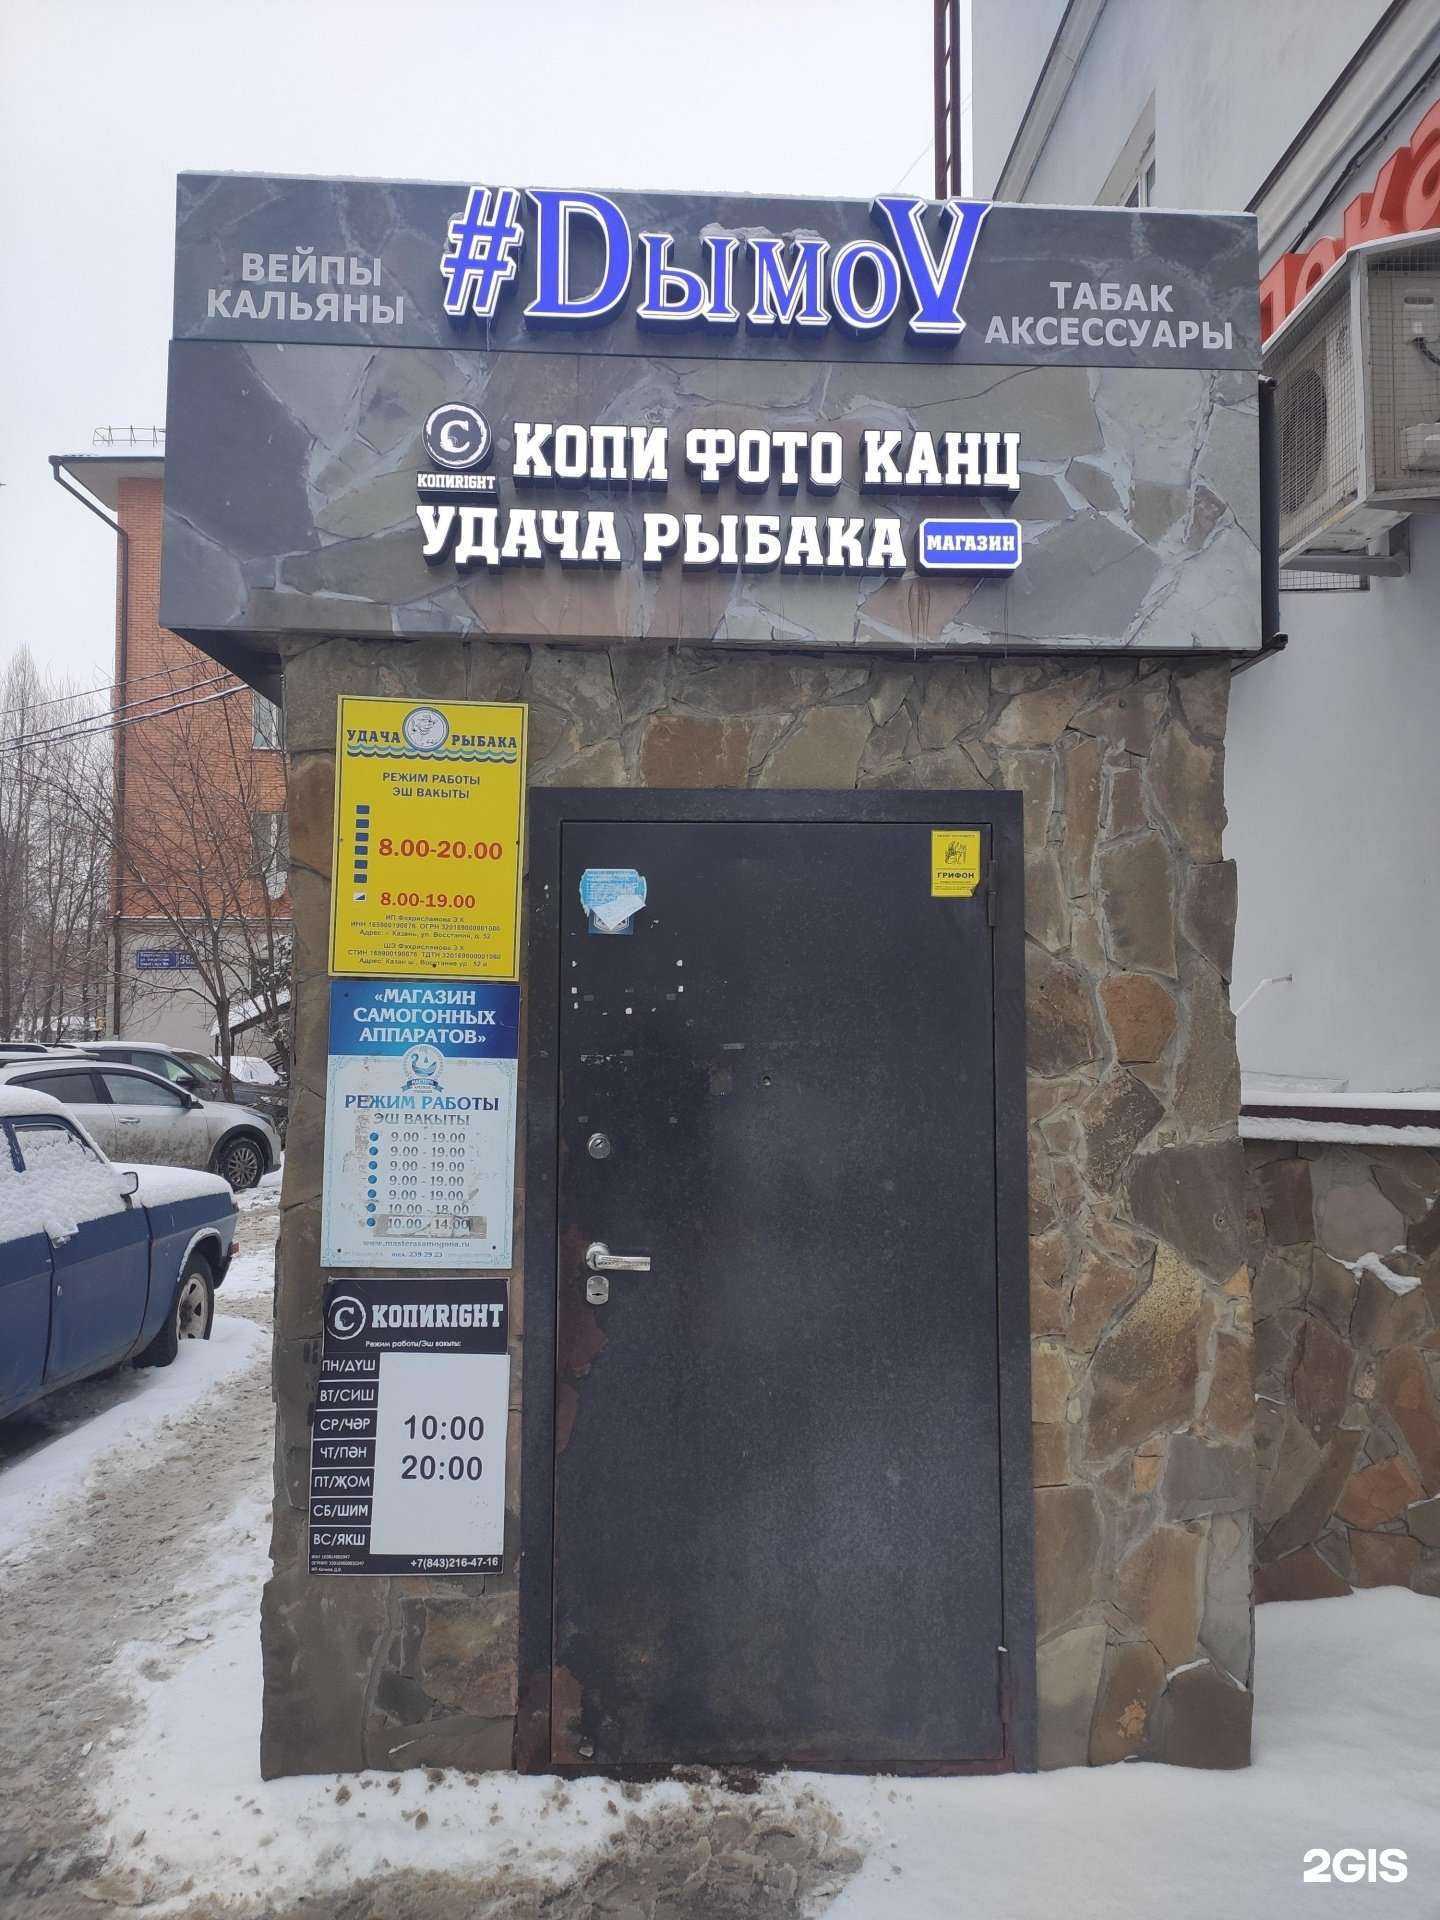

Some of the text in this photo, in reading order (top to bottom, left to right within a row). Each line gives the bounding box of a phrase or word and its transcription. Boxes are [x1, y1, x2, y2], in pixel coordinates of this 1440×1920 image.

[242, 246, 382, 286] ВЕЙПЫ
[1050, 281, 1174, 313] ТАБАК
[206, 290, 405, 325] КАЛЬЯНЫ
[985, 315, 1234, 351] АКСЕССУАРЫ
[513, 422, 1021, 491] КОПИ ФОТО КАНЦ
[416, 506, 907, 570] УДАЧА РЫБАКА
[926, 534, 1016, 553] МАГАЗИН
[347, 729, 517, 748] УДАЧА РЫБАКА
[382, 772, 480, 785] РЕЖИМ РАБОТЫ
[392, 787, 469, 799] ЭШ ВАКЫТЫ
[379, 838, 503, 860] 8.00-20.00
[380, 892, 475, 909] 8.00-19.00
[374, 989, 476, 1005] «МАГАЗИН
[353, 1007, 496, 1025] САМОГОННЫХ
[359, 1027, 486, 1044] АППАРАТОВ»
[345, 1094, 499, 1111] РЕЖИМ РАБОТЫ
[373, 1113, 470, 1126] ЭШ ВАКЫТЫ
[391, 1132, 419, 1142] 9.00
[432, 1133, 465, 1143] 19.00
[390, 1146, 419, 1157] 9.00
[431, 1147, 465, 1157] 19.00
[390, 1161, 418, 1172] 9.00
[431, 1161, 465, 1172] 19.00
[389, 1175, 418, 1186] 9.00
[431, 1176, 464, 1187] 19.00
[389, 1190, 417, 1200] 9.00
[430, 1190, 464, 1201] 19.00
[389, 1204, 423, 1214] 10.00
[435, 1204, 470, 1215] 18.00
[366, 1340, 390, 1348] Режим
[320, 1389, 374, 1402] ВТ/СИШ
[404, 1415, 484, 1441] 10:00
[400, 1455, 483, 1480] 20:00
[313, 1504, 368, 1517] СБ/ШИМ
[313, 1533, 366, 1547] ВС/ЯКШ
[410, 1557, 498, 1569] +7(843)216-47-16
